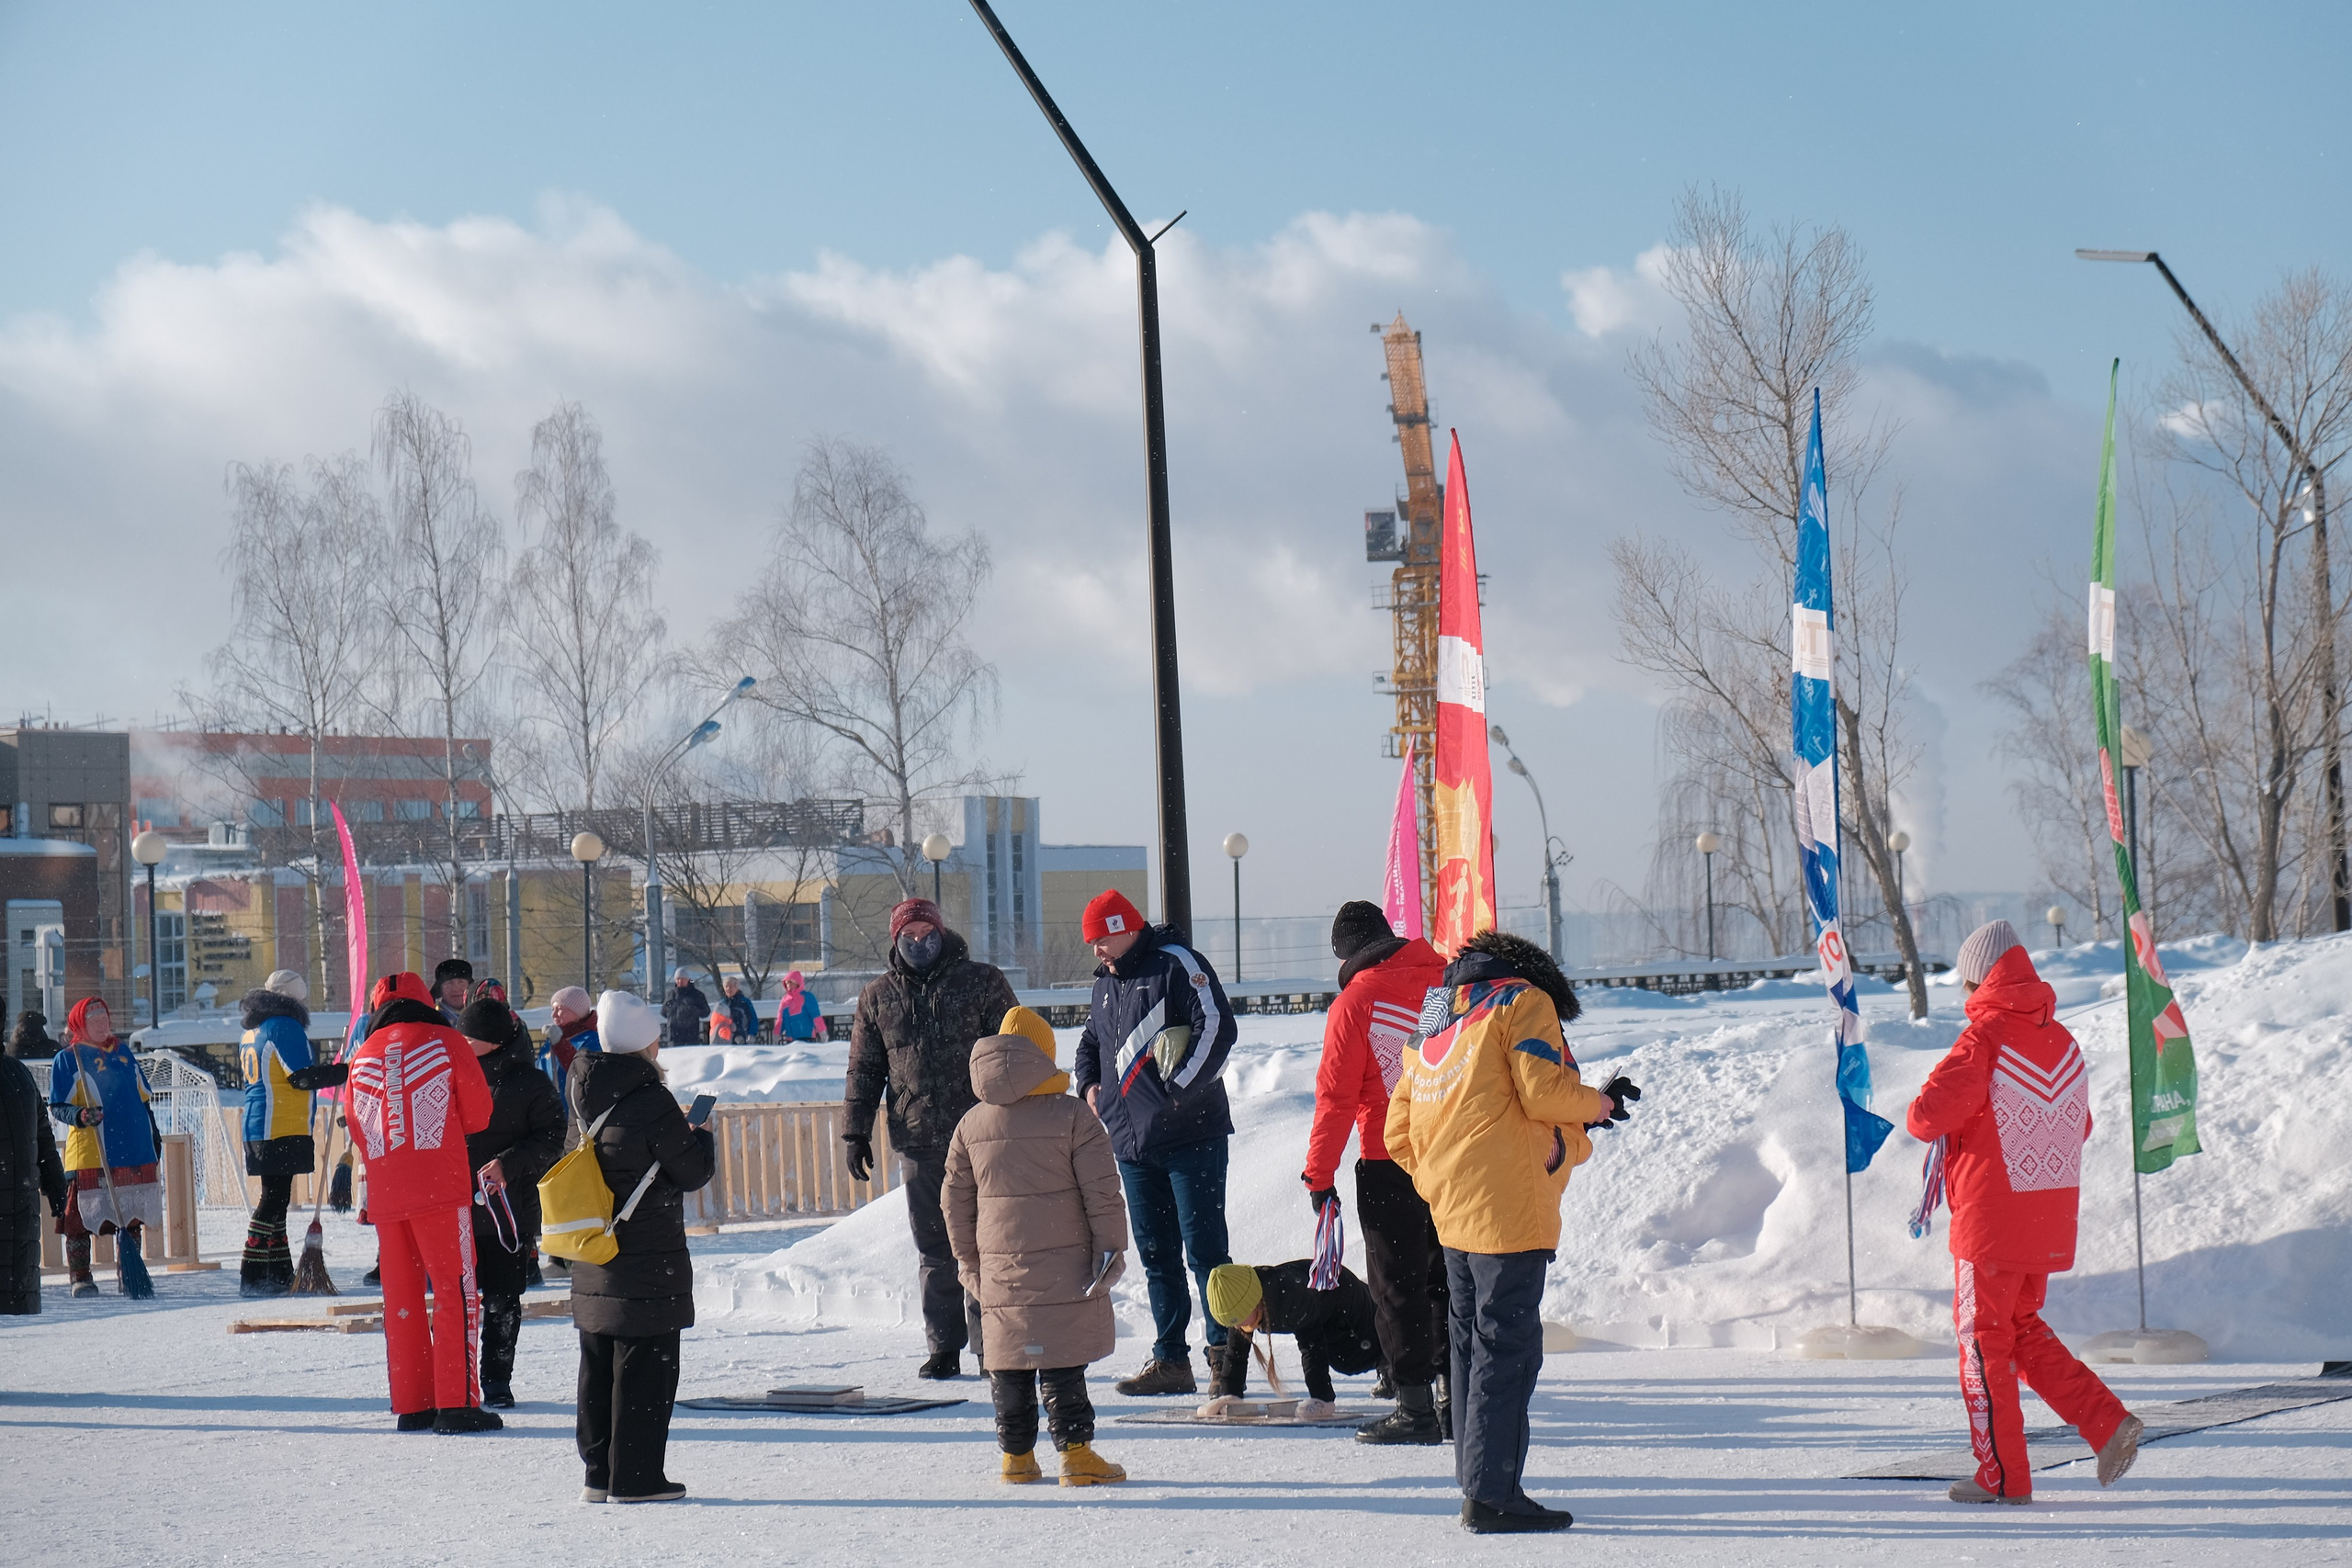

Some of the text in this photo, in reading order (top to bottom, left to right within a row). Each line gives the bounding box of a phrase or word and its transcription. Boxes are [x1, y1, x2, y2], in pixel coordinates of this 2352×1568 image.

[95, 1057, 107, 1072] 2
[1407, 1043, 1476, 1089] бровольцы
[384, 1042, 405, 1151] UDMURTIA
